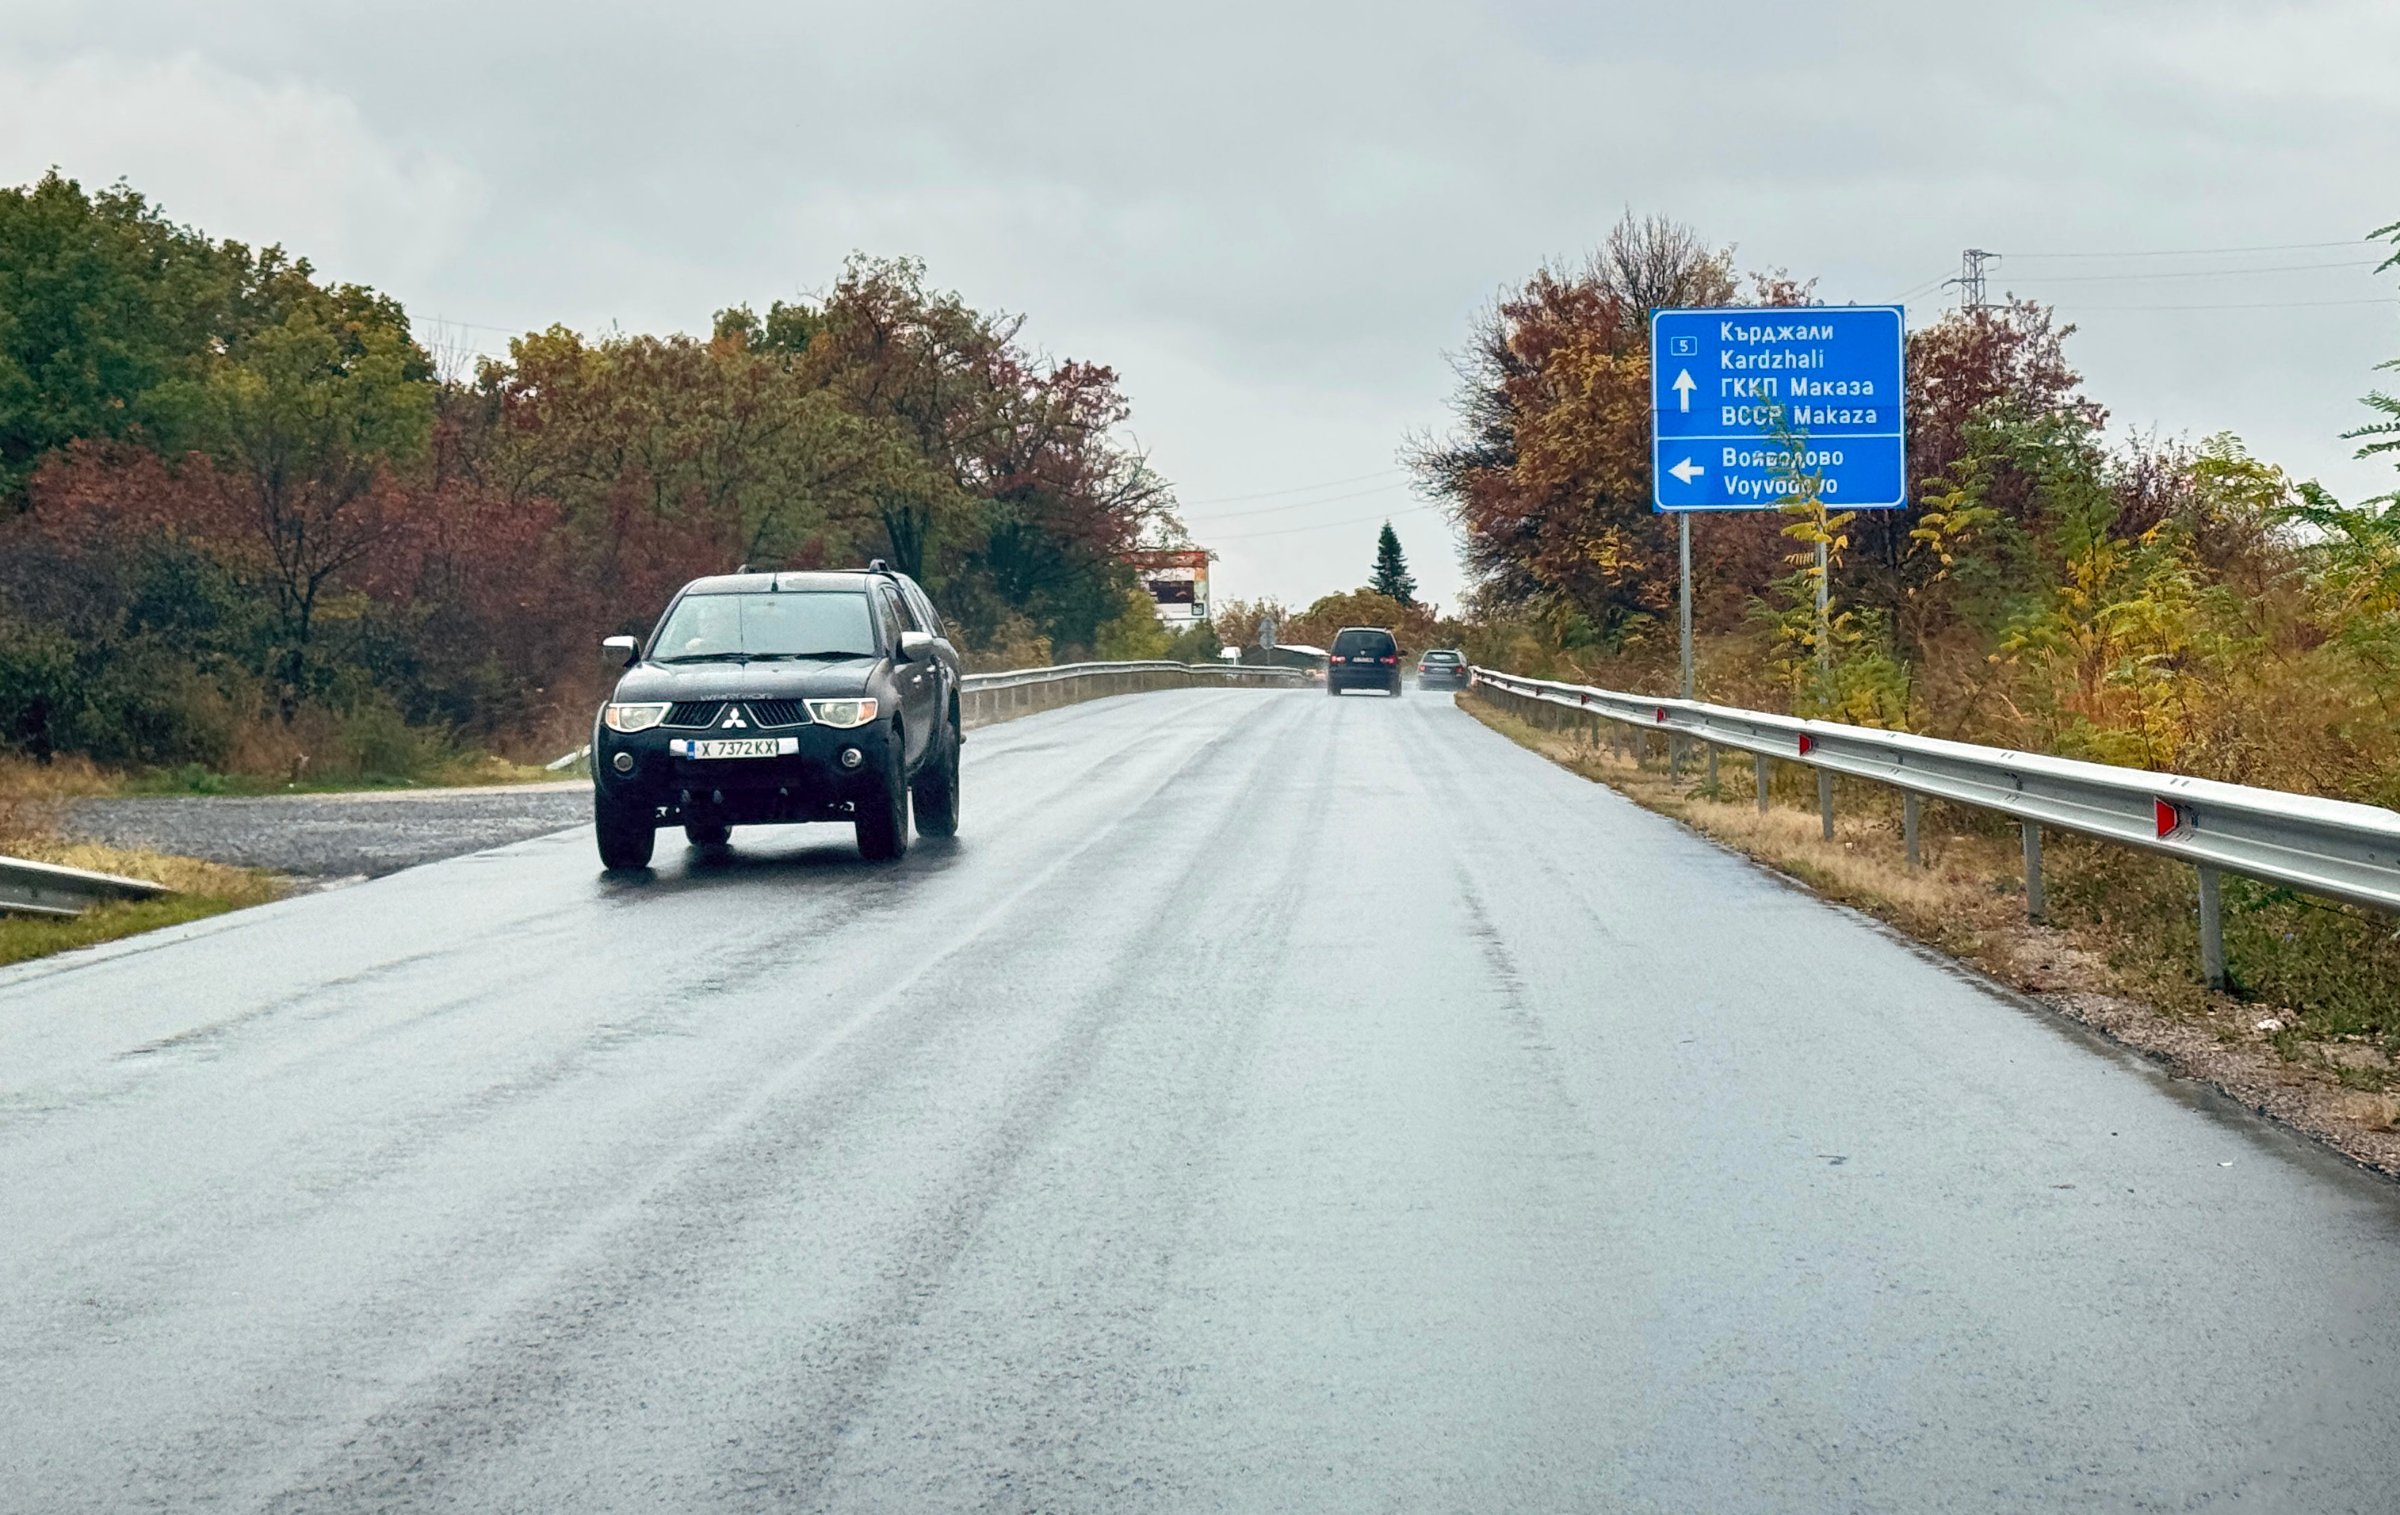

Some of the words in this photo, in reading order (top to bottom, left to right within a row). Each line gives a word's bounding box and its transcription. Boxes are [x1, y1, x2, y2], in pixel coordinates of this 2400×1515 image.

[1720, 321, 1833, 346] Кърджали
[1679, 340, 1689, 353] 5
[1720, 349, 1824, 369] Kardzhali
[1721, 377, 1778, 398] ГККП
[1790, 377, 1874, 396] Маказа
[1794, 405, 1877, 425] Makaza
